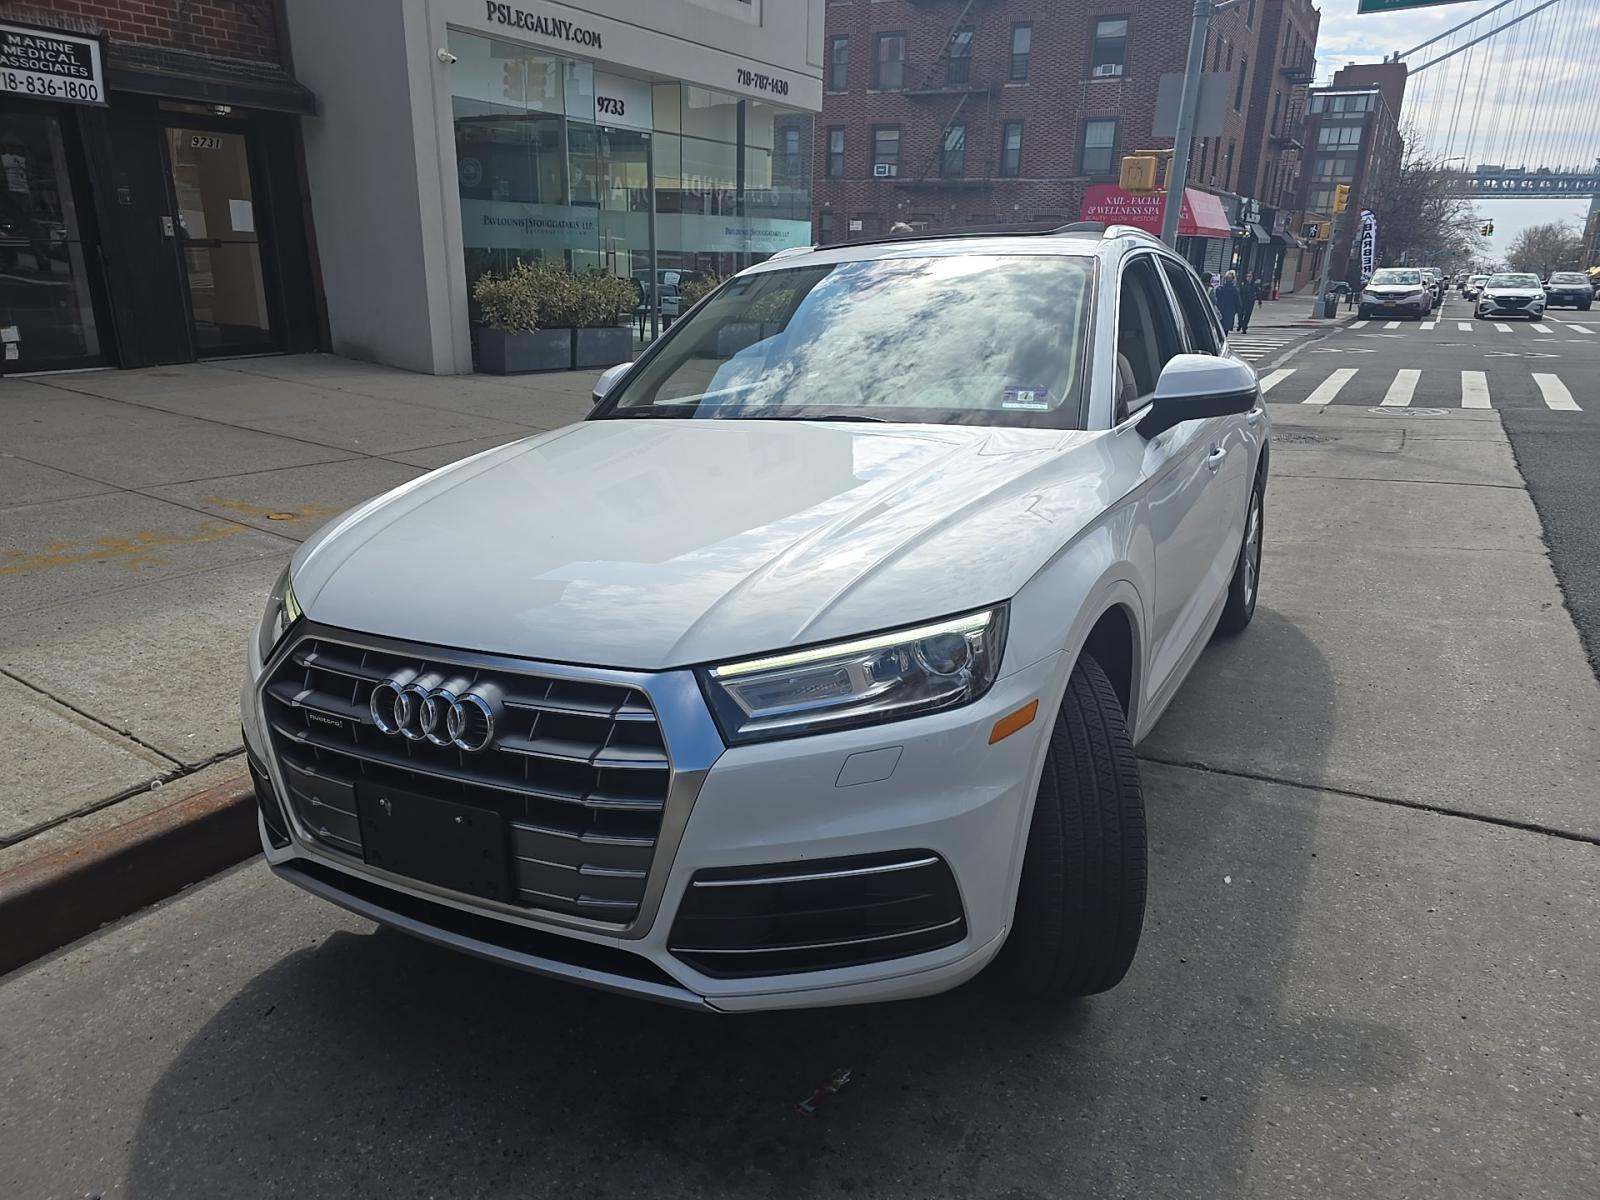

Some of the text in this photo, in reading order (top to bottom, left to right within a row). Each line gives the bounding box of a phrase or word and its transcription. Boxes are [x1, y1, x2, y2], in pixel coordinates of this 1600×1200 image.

[486, 0, 602, 49] PSLEGALNY.COM
[7, 34, 74, 54] MARINE
[2, 43, 81, 66] MEDICAL
[0, 54, 89, 77] ASSOCIATES
[597, 96, 625, 116] 9733
[192, 136, 220, 148] 9731
[1097, 206, 1141, 215] WELLNESS
[1142, 206, 1160, 215] SPA
[1105, 196, 1126, 205] NAIL
[1131, 196, 1161, 205] FACIAL
